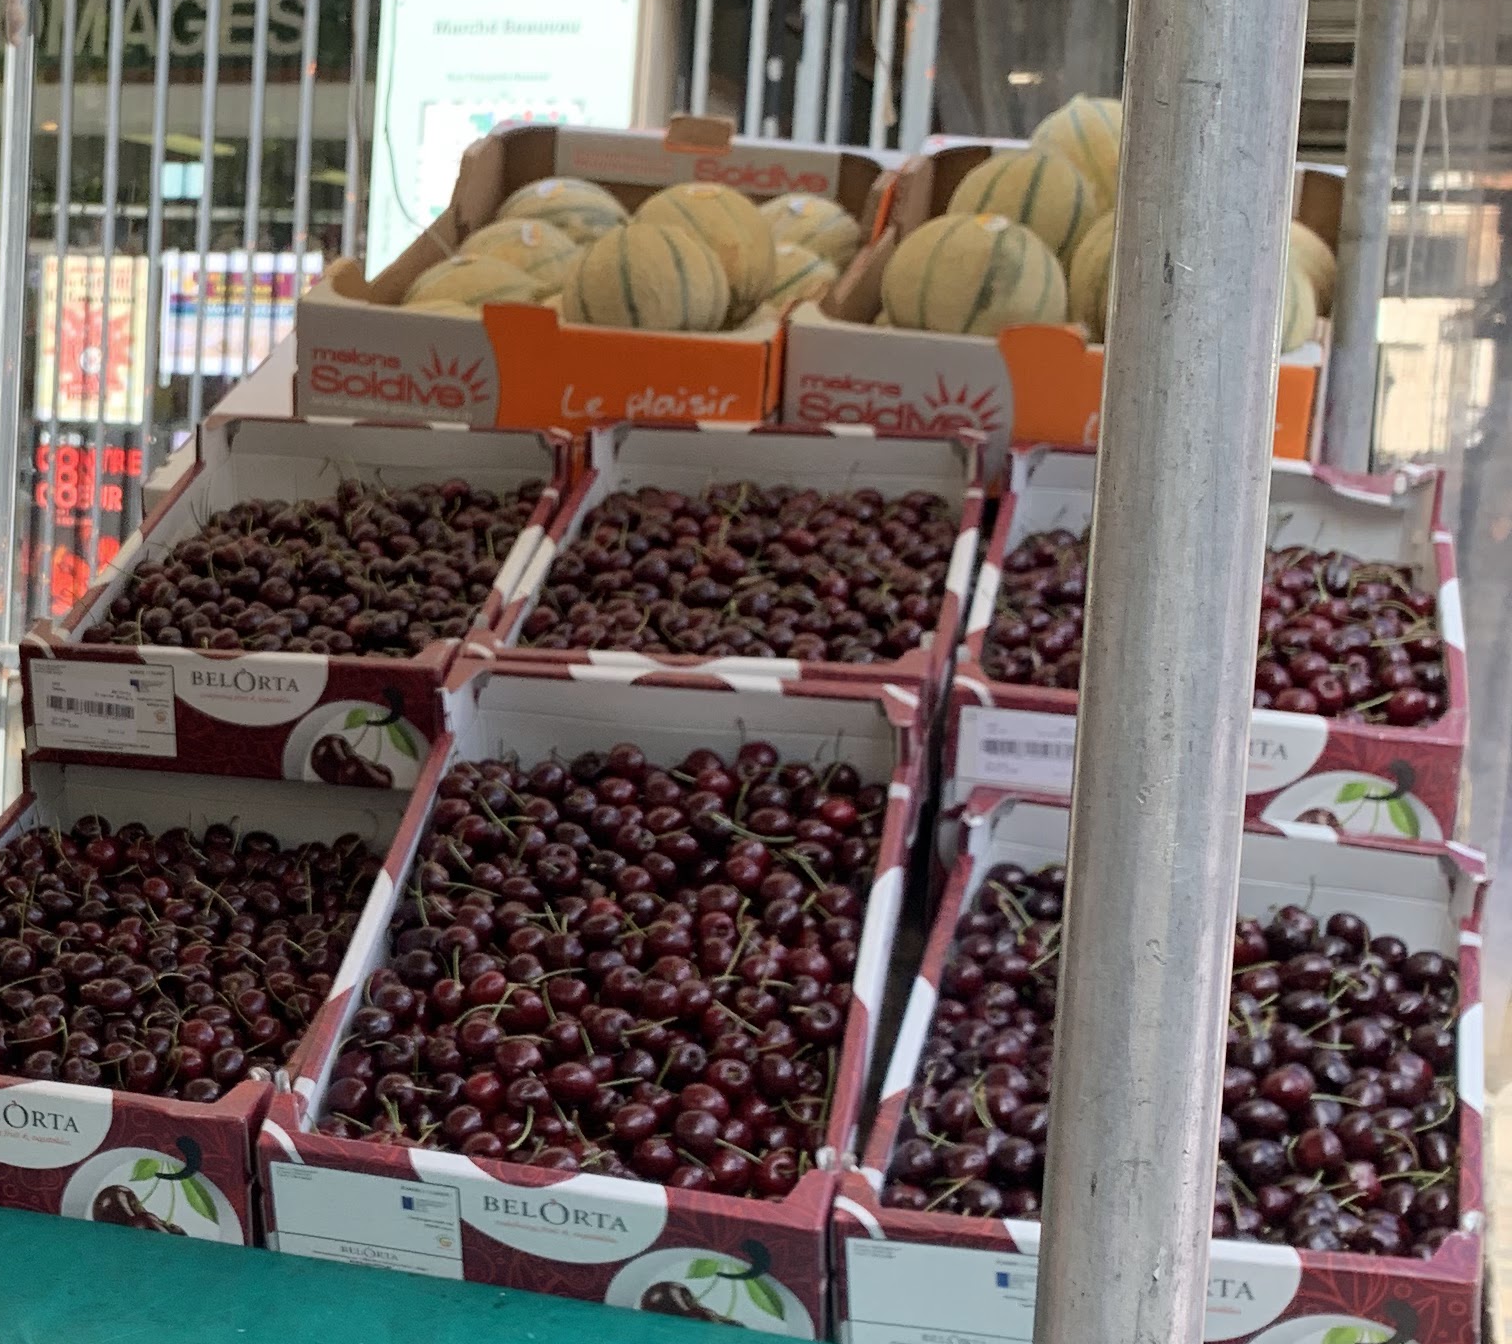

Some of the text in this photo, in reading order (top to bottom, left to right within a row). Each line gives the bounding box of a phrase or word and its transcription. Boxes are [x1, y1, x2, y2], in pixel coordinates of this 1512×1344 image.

[311, 347, 402, 370] melons
[799, 373, 903, 398] melons
[561, 385, 740, 419] Le plaisir
